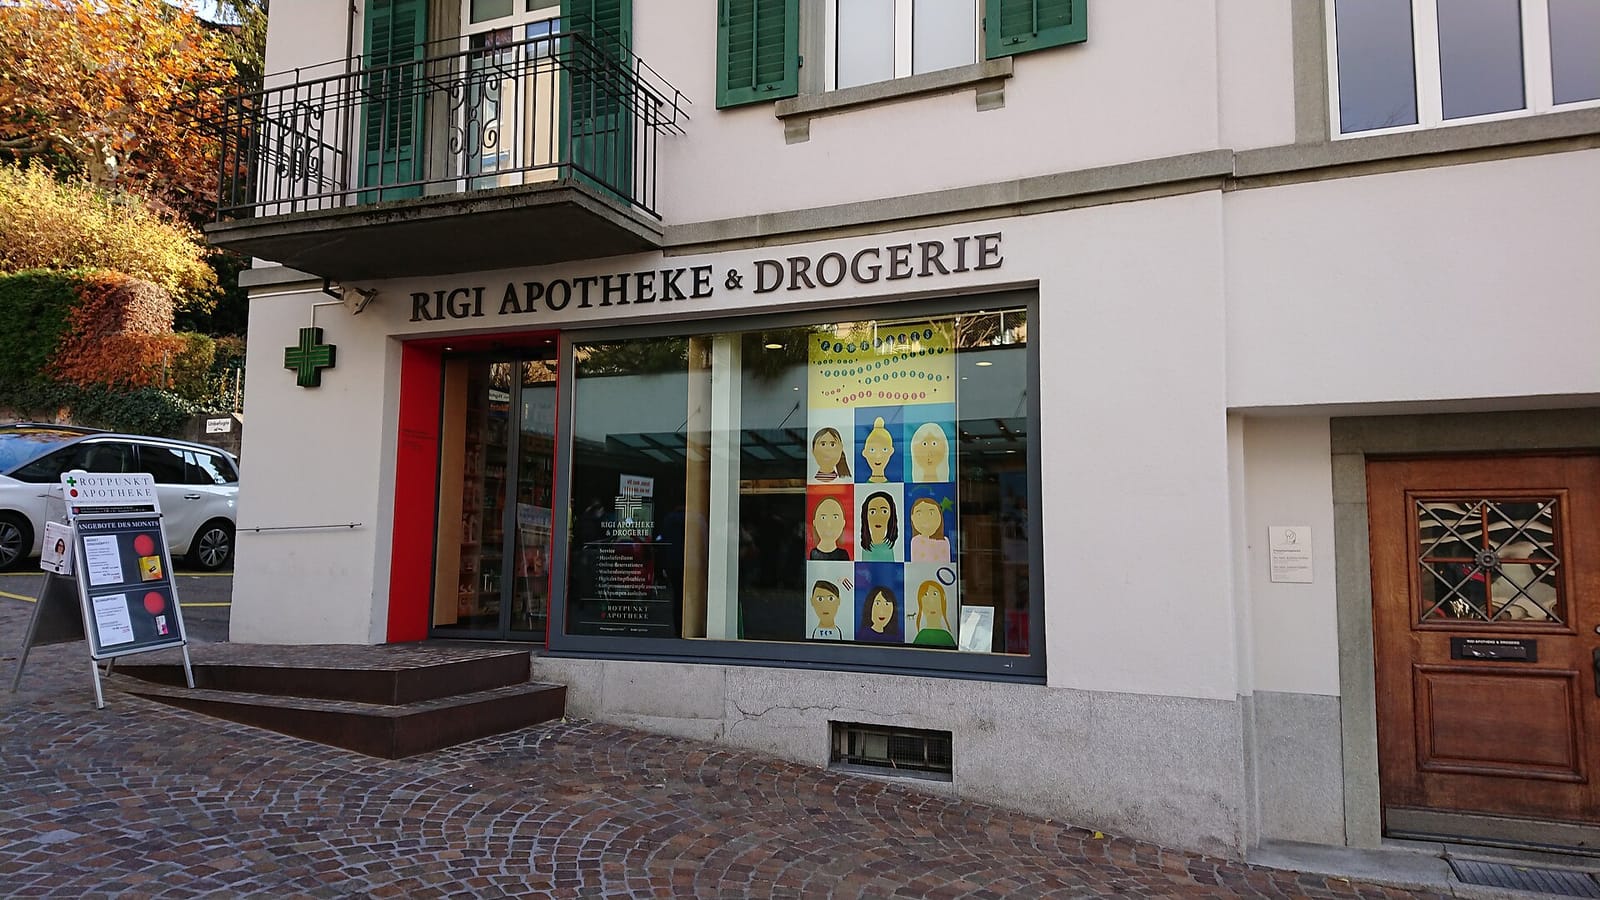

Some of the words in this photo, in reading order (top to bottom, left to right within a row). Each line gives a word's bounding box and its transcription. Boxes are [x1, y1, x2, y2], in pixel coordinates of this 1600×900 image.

[409, 286, 486, 322] RIGI
[498, 264, 713, 315] APOTHEKE
[724, 269, 744, 290] &
[753, 232, 1004, 294] DROGERIE
[80, 477, 150, 486] ROTPUNKT
[82, 488, 152, 497] APOTHEKE
[78, 522, 114, 530] ANGEBOTE
